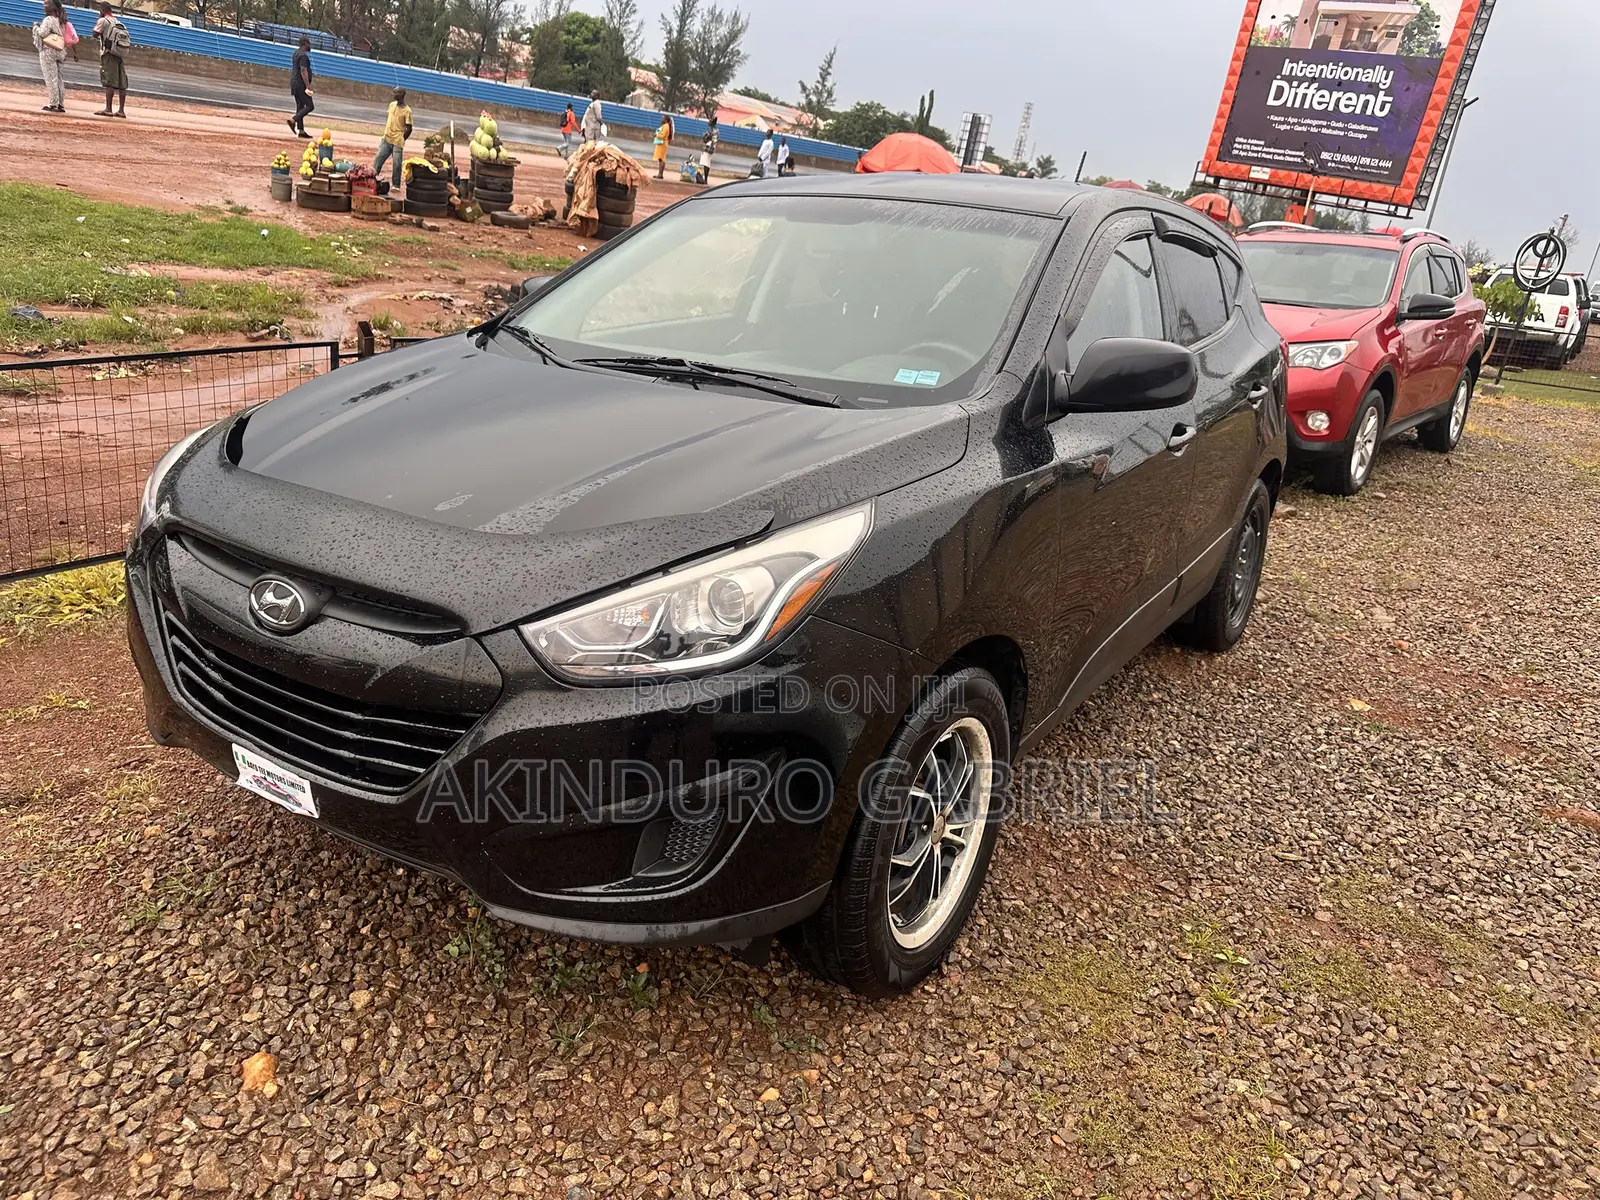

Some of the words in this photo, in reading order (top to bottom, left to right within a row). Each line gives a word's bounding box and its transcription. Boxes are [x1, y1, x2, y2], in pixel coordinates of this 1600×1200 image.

[1282, 58, 1394, 89] Intentionally
[1266, 78, 1394, 117] Different
[1275, 123, 1291, 131] Lugbe
[1301, 117, 1327, 126] Lokogoma
[1330, 120, 1345, 128] Gudu
[1378, 159, 1393, 168] 4444
[266, 770, 286, 785] MOTORS
[286, 778, 306, 793] LIMITED
